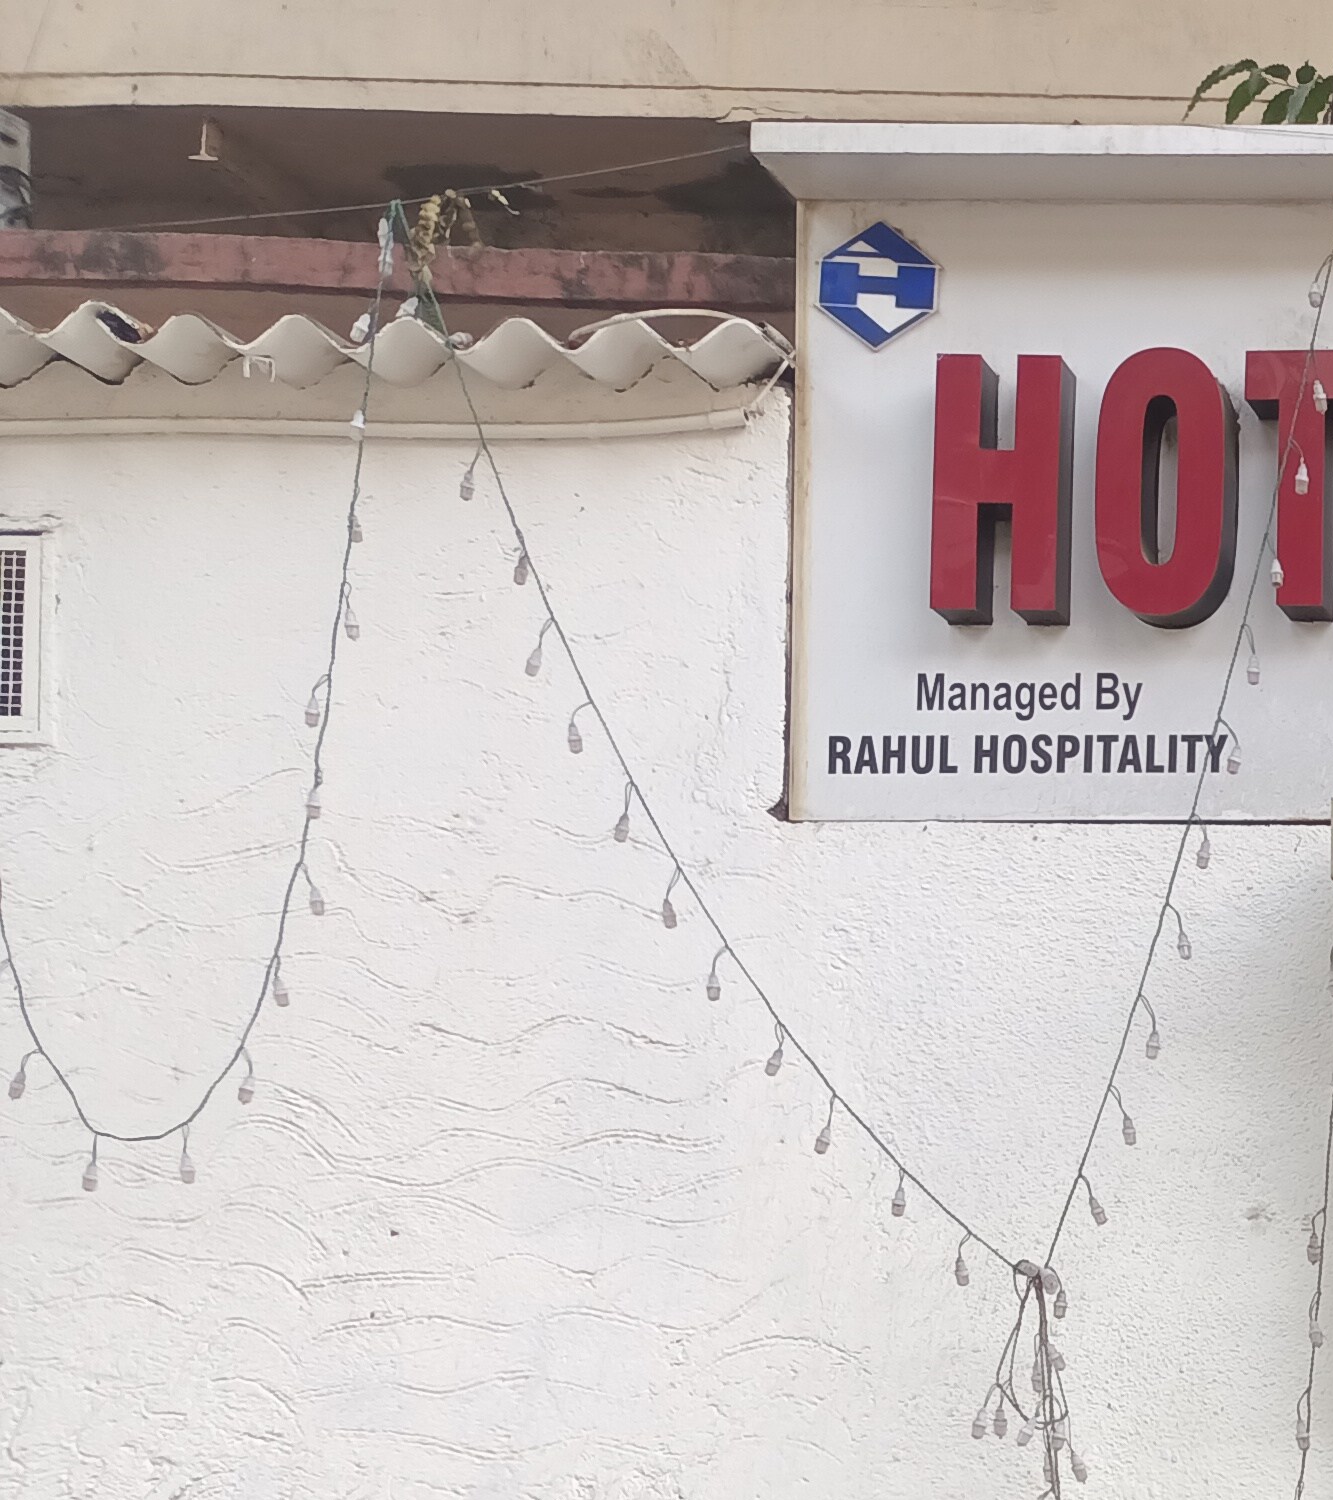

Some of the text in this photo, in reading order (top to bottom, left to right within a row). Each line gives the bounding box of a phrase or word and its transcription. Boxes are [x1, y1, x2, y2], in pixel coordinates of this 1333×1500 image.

[916, 672, 1143, 721] Managed By
[827, 734, 1229, 775] RAHUL HOSPITALITY
